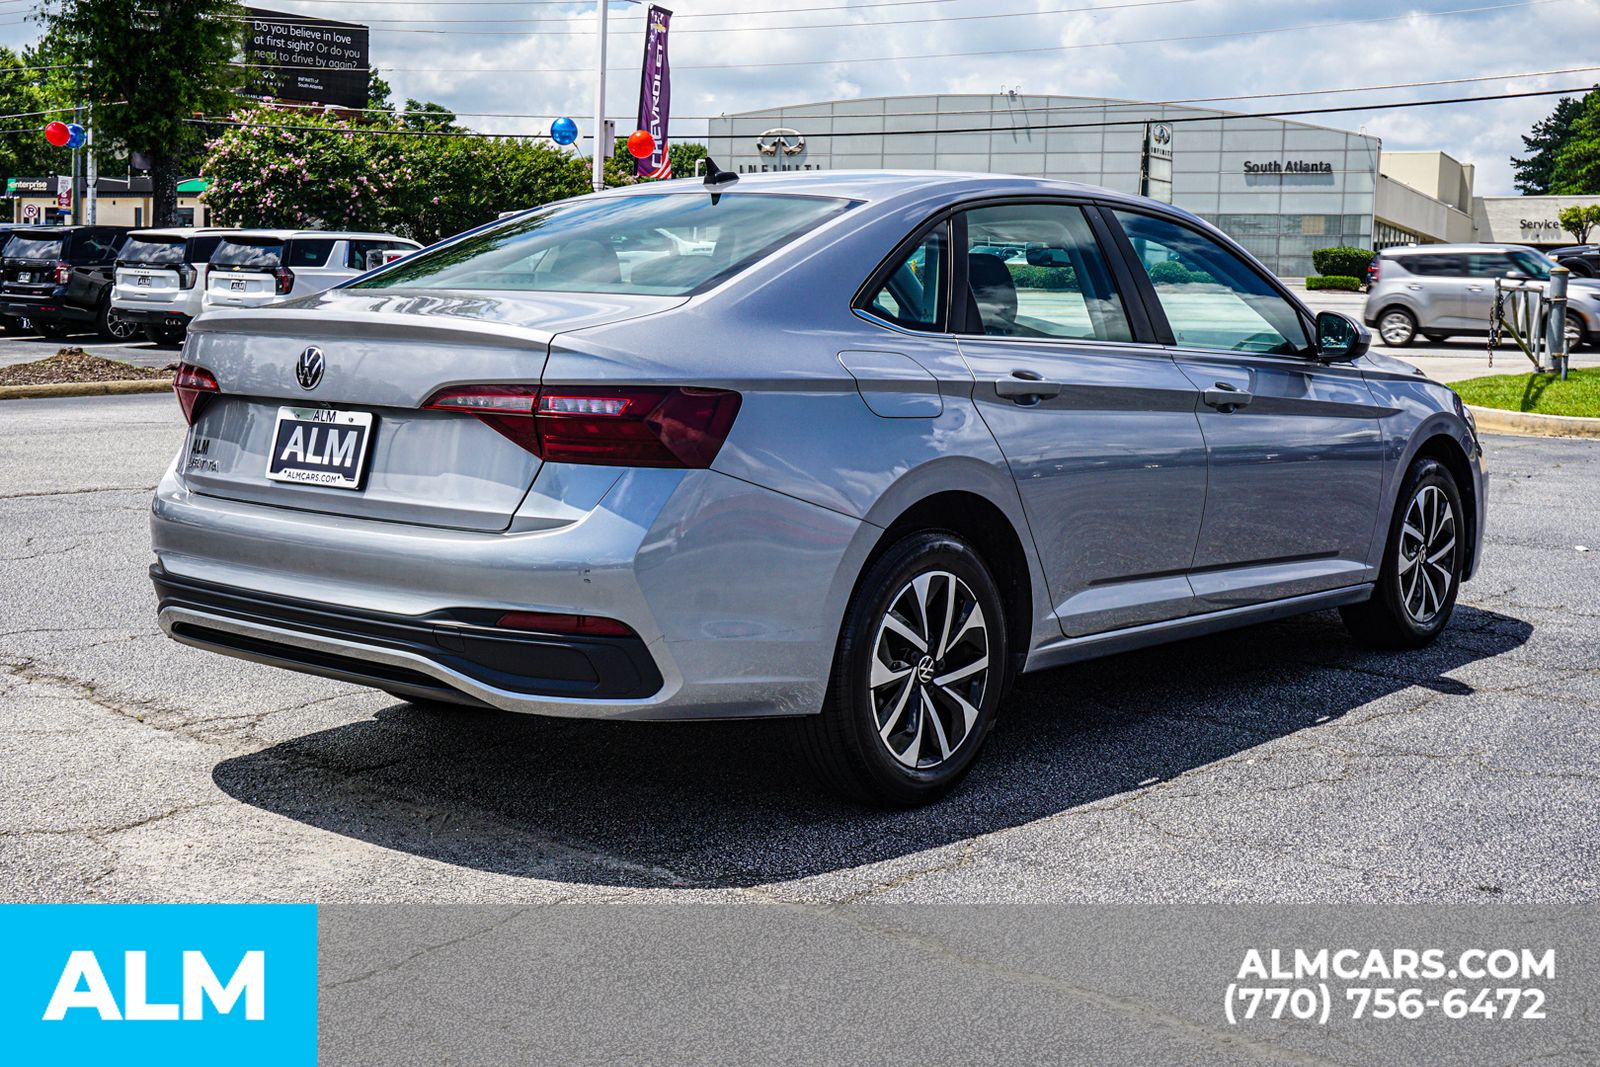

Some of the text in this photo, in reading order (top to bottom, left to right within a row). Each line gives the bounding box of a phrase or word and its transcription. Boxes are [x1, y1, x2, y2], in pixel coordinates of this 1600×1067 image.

[254, 20, 352, 45] Do you believe in love
[254, 35, 360, 59] at first sight? Or do you
[279, 52, 290, 62] to
[291, 53, 314, 65] drive
[315, 55, 326, 68] by
[328, 60, 358, 70] again?
[651, 42, 663, 168] CHEVROLET
[739, 164, 820, 174] INFINITI
[1243, 160, 1332, 173] South Atlanta
[8, 180, 48, 190] enterprise
[1520, 219, 1559, 230] Service
[312, 409, 336, 423] ALM
[191, 439, 210, 455] ALM
[280, 425, 358, 468] ALM
[286, 470, 338, 484] ALMCARS.COM
